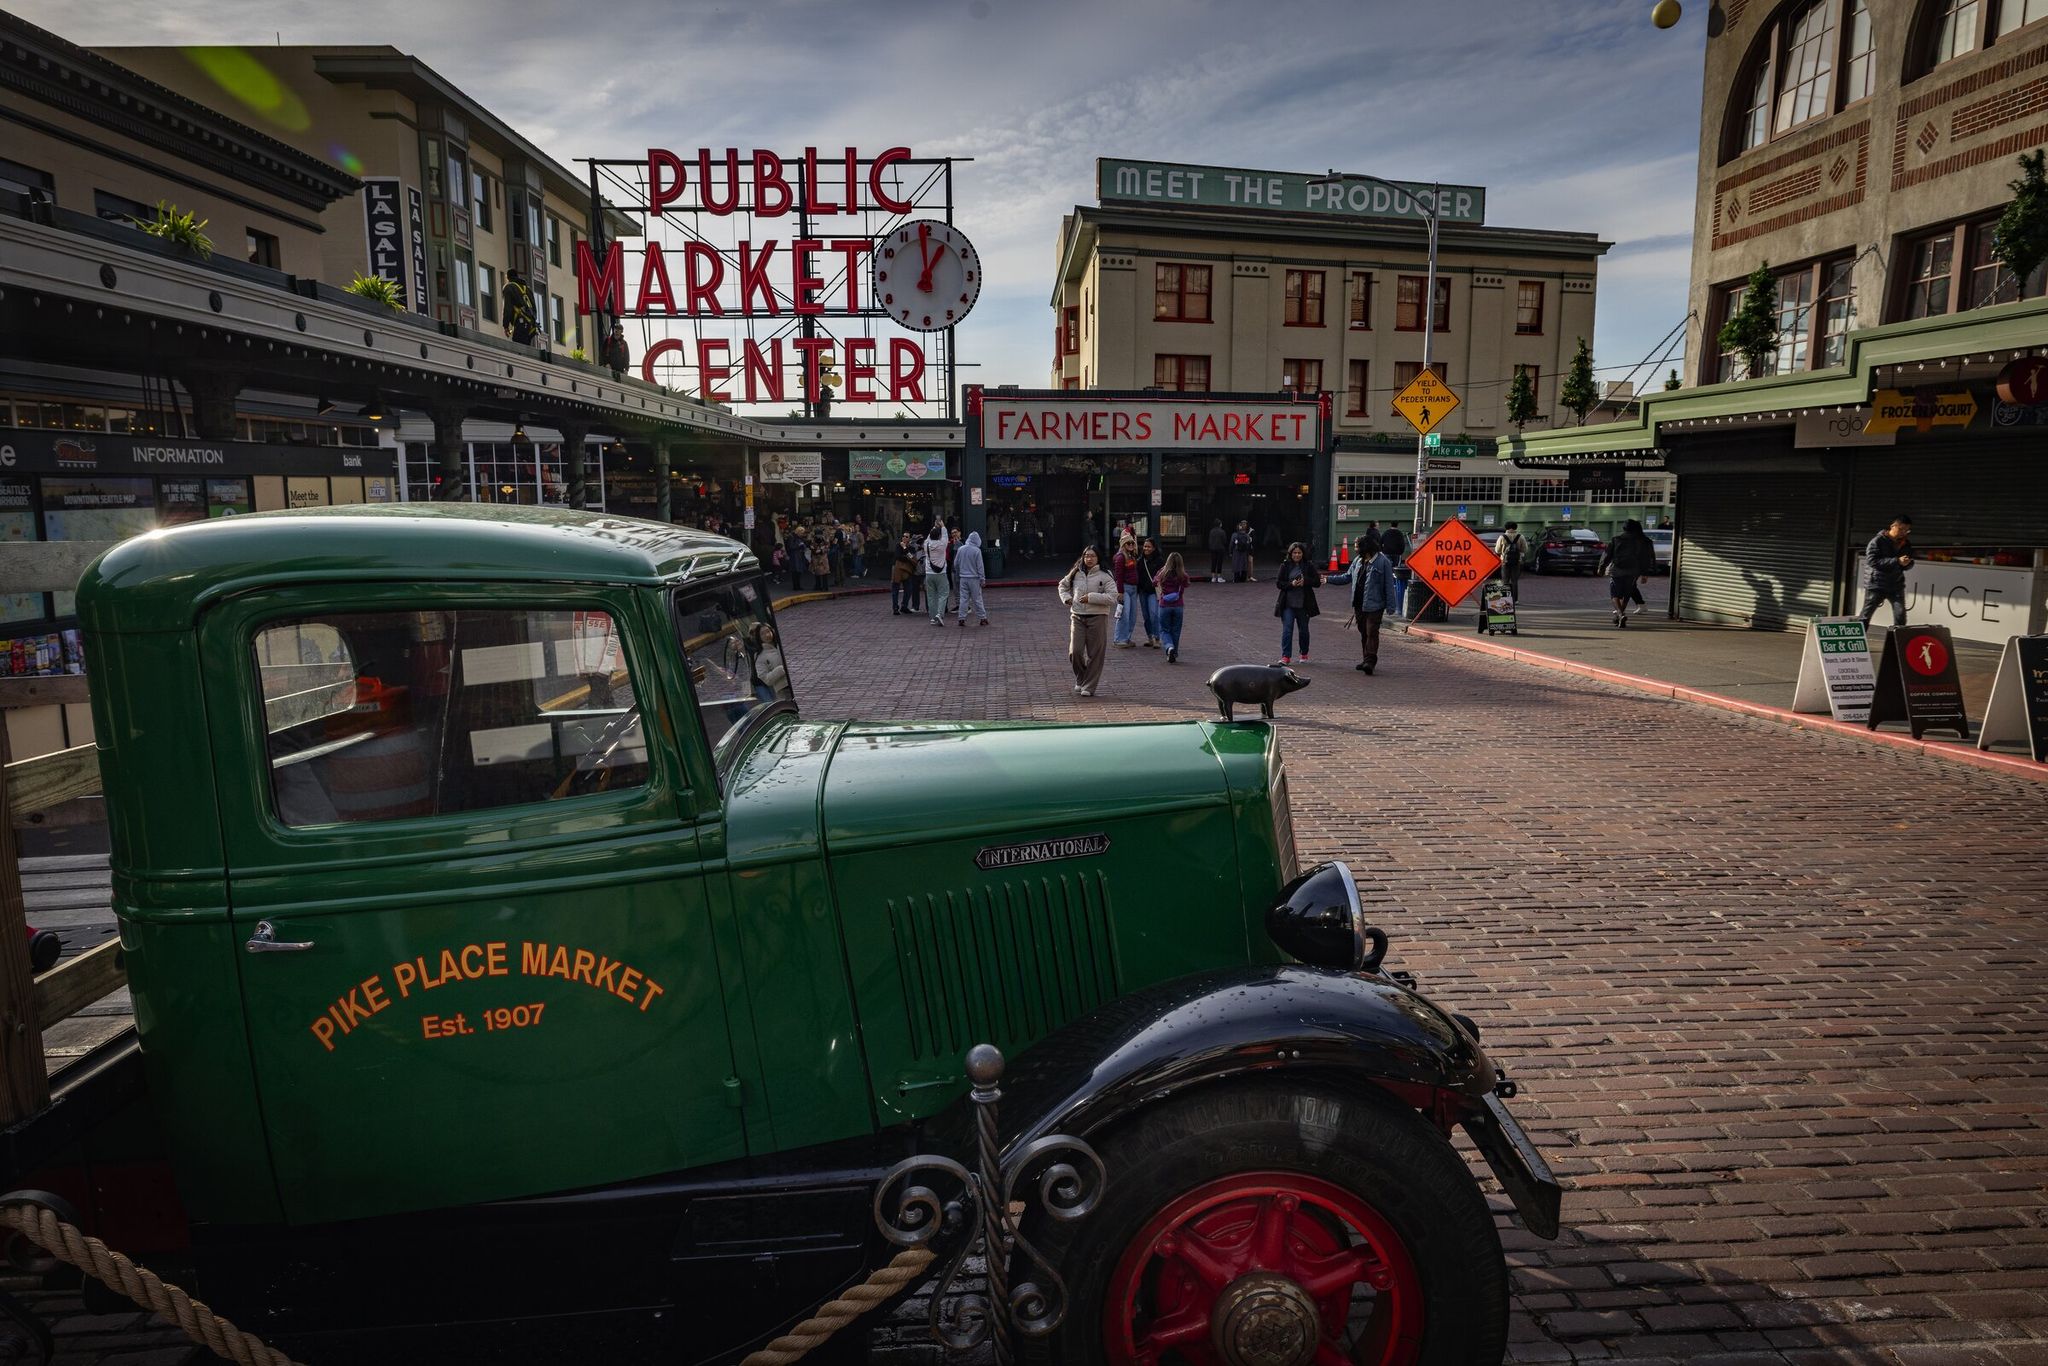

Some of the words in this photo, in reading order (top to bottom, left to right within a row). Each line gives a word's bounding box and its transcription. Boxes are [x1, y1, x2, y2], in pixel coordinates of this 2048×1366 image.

[648, 147, 913, 217] PUBLIC
[1116, 166, 1205, 199] MEET
[1224, 174, 1284, 206] THE
[1305, 182, 1472, 218] PRODUCER
[372, 185, 395, 215] LA
[409, 191, 421, 223] LA
[900, 231, 908, 243] 11
[946, 231, 949, 242] 1
[374, 222, 399, 283] SALL
[884, 248, 895, 259] 10
[961, 248, 968, 259] 2
[412, 230, 427, 305] SALLE
[577, 239, 875, 317] MARKET
[879, 271, 887, 281] 9
[966, 270, 974, 281] 3
[885, 293, 893, 304] 8
[960, 293, 969, 304] 4
[902, 310, 910, 321] 7
[946, 310, 954, 320] 5
[923, 316, 931, 327] 6
[643, 337, 926, 404] CENTER
[1400, 395, 1451, 403] PEDESTRIANS
[998, 410, 1153, 441] FARMERS
[1173, 411, 1308, 442] MARKET
[132, 446, 225, 464] INFORMATION
[1431, 446, 1451, 456] Pike
[343, 455, 362, 467] bank
[64, 495, 100, 504] DOWNTOWN
[100, 495, 123, 504] SEATTLE
[123, 495, 136, 503] MAP
[290, 490, 307, 501] Meet
[309, 490, 319, 501] the
[1435, 540, 1471, 551] ROAD
[1435, 555, 1471, 565] WORK
[1432, 569, 1477, 580] AHEAD
[1878, 582, 2003, 622] UICE
[1820, 625, 1838, 636] Pike
[1838, 624, 1861, 636] Place
[1822, 640, 1837, 652] Bar
[1838, 640, 1847, 651] &
[1847, 639, 1866, 651] Grill
[984, 837, 1103, 866] INTERNATIONAL
[310, 973, 392, 1052] PIKE
[393, 940, 511, 999] PLACE
[520, 940, 666, 1014] MARKET
[421, 1012, 475, 1041] Est.
[482, 1001, 546, 1033] 1907
